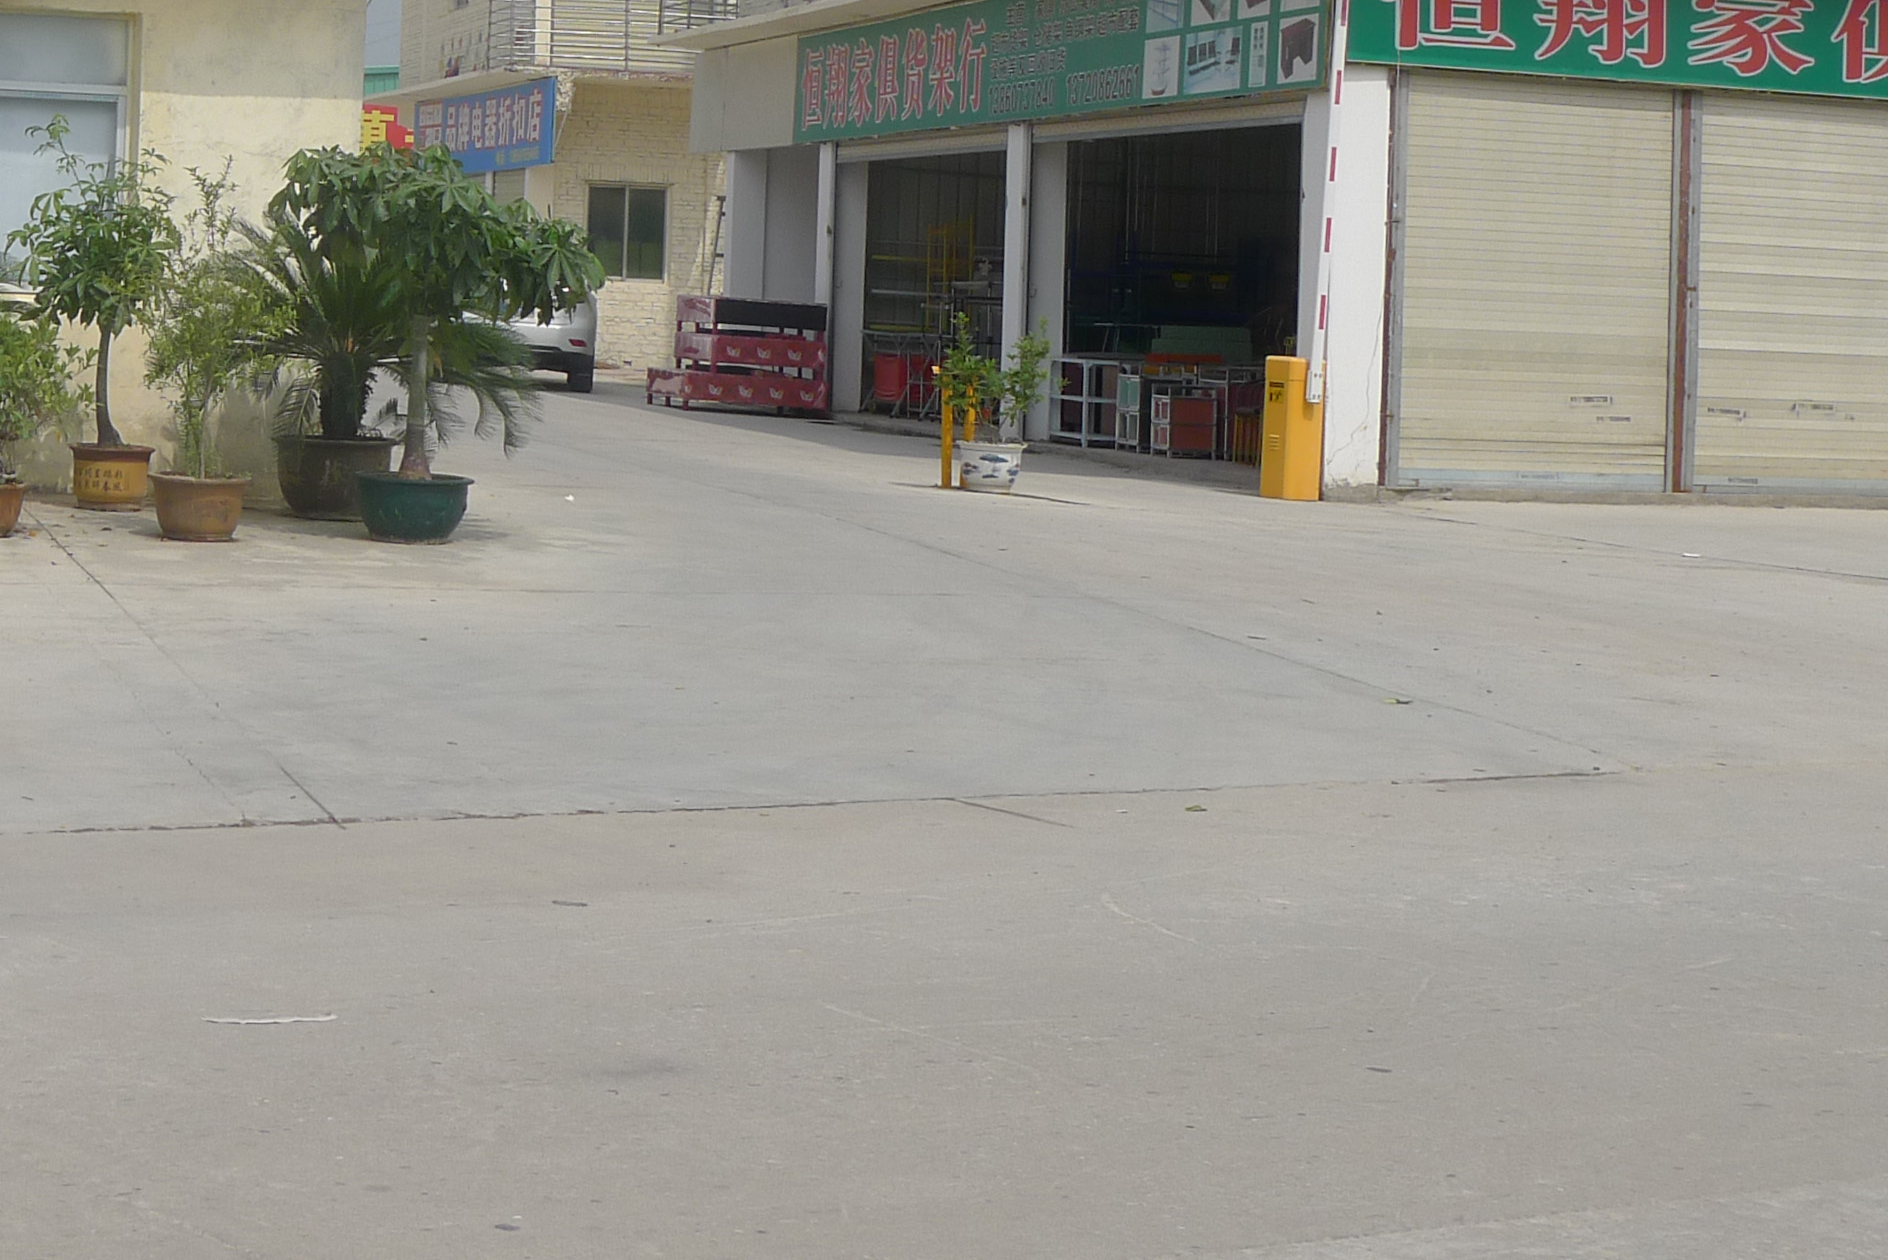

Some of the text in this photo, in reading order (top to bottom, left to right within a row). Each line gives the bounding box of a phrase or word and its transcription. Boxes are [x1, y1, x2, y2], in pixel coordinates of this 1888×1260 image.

[801, 17, 987, 131] 恒翔家俱货架行
[1066, 64, 1141, 106] 13720862661
[445, 89, 543, 153] 品牌电器折扣店
